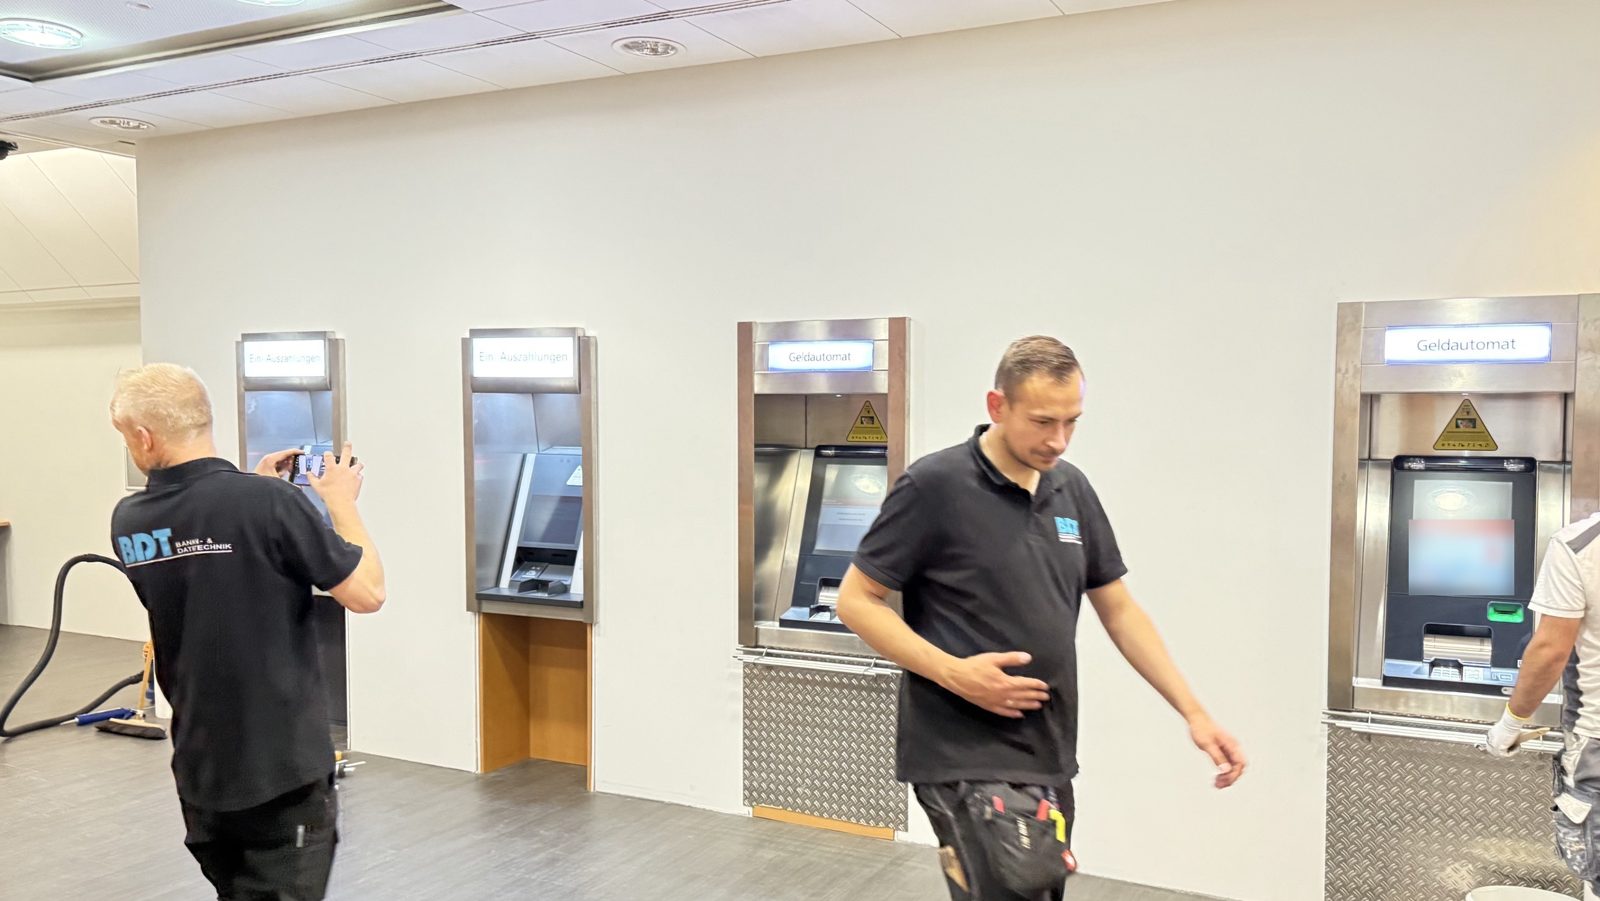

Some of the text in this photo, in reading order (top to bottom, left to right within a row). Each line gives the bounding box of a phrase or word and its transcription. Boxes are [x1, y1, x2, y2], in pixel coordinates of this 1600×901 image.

[1416, 338, 1517, 351] Geldautomat
[788, 351, 852, 362] Geldautomat
[118, 527, 173, 564] BDT
